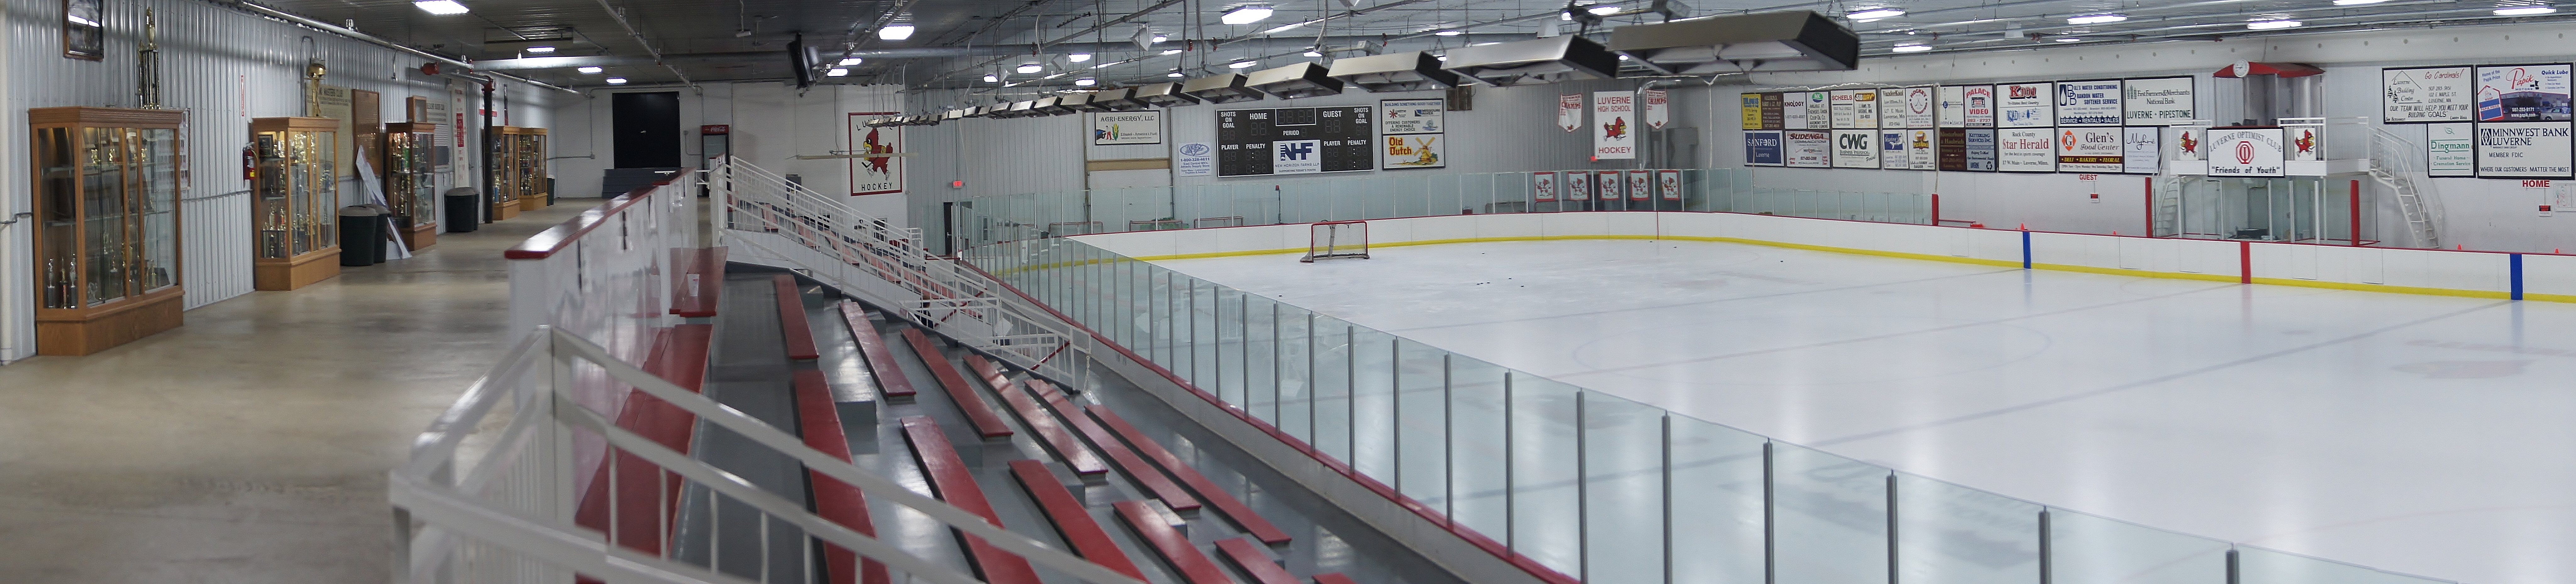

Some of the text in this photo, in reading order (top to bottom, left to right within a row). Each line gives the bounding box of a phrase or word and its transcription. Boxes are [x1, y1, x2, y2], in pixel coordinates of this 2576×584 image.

[2434, 68, 2464, 79] Cardinals!
[2506, 68, 2534, 89] Papik
[1966, 88, 1990, 99] PALACE
[2010, 85, 2037, 99] K101
[2159, 110, 2191, 118] PIPESTONE
[2085, 132, 2114, 143] Glen's
[2493, 128, 2569, 137] MINNWEST BANK
[1389, 137, 1403, 146] Old
[1839, 133, 1868, 149] CWG
[2003, 138, 2049, 149] Star Herald
[2210, 131, 2282, 152] LUVERNE OPTIMIST CLUB
[2493, 137, 2532, 146] LUVERNE
[1280, 142, 1313, 161] NHF
[1389, 146, 1412, 155] Dutch
[2431, 141, 2469, 153] Dingmann
[862, 182, 892, 191] HOCKEY
